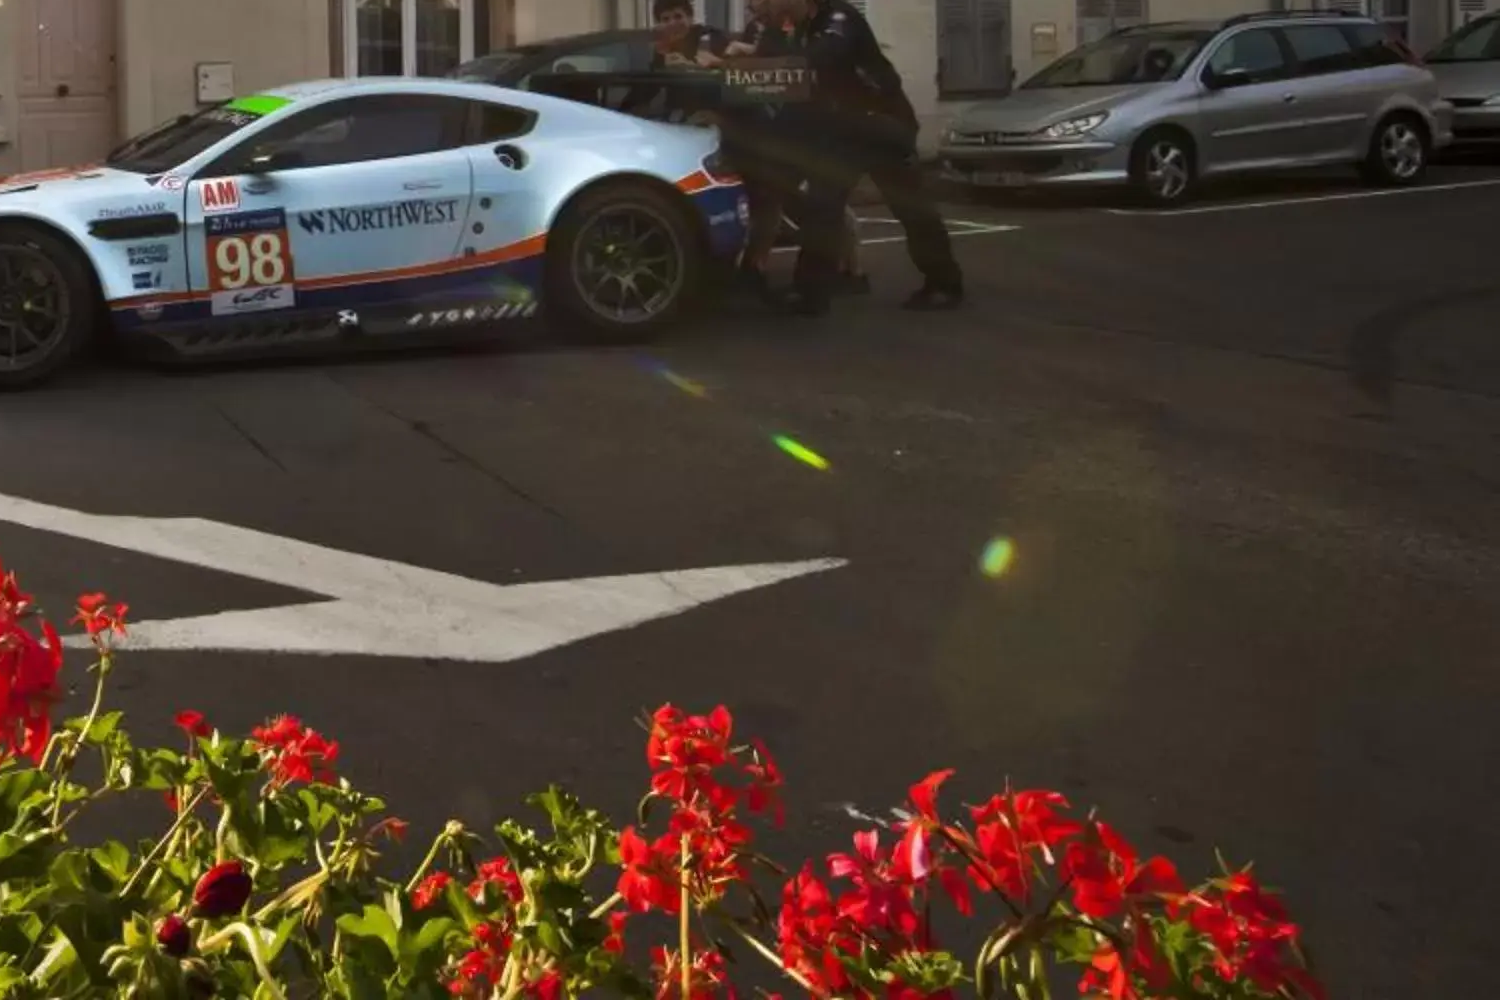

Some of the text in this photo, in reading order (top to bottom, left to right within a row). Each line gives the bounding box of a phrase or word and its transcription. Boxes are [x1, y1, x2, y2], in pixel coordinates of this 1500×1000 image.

[725, 68, 805, 86] HACKETT
[203, 180, 236, 207] AM
[215, 233, 285, 290] 98
